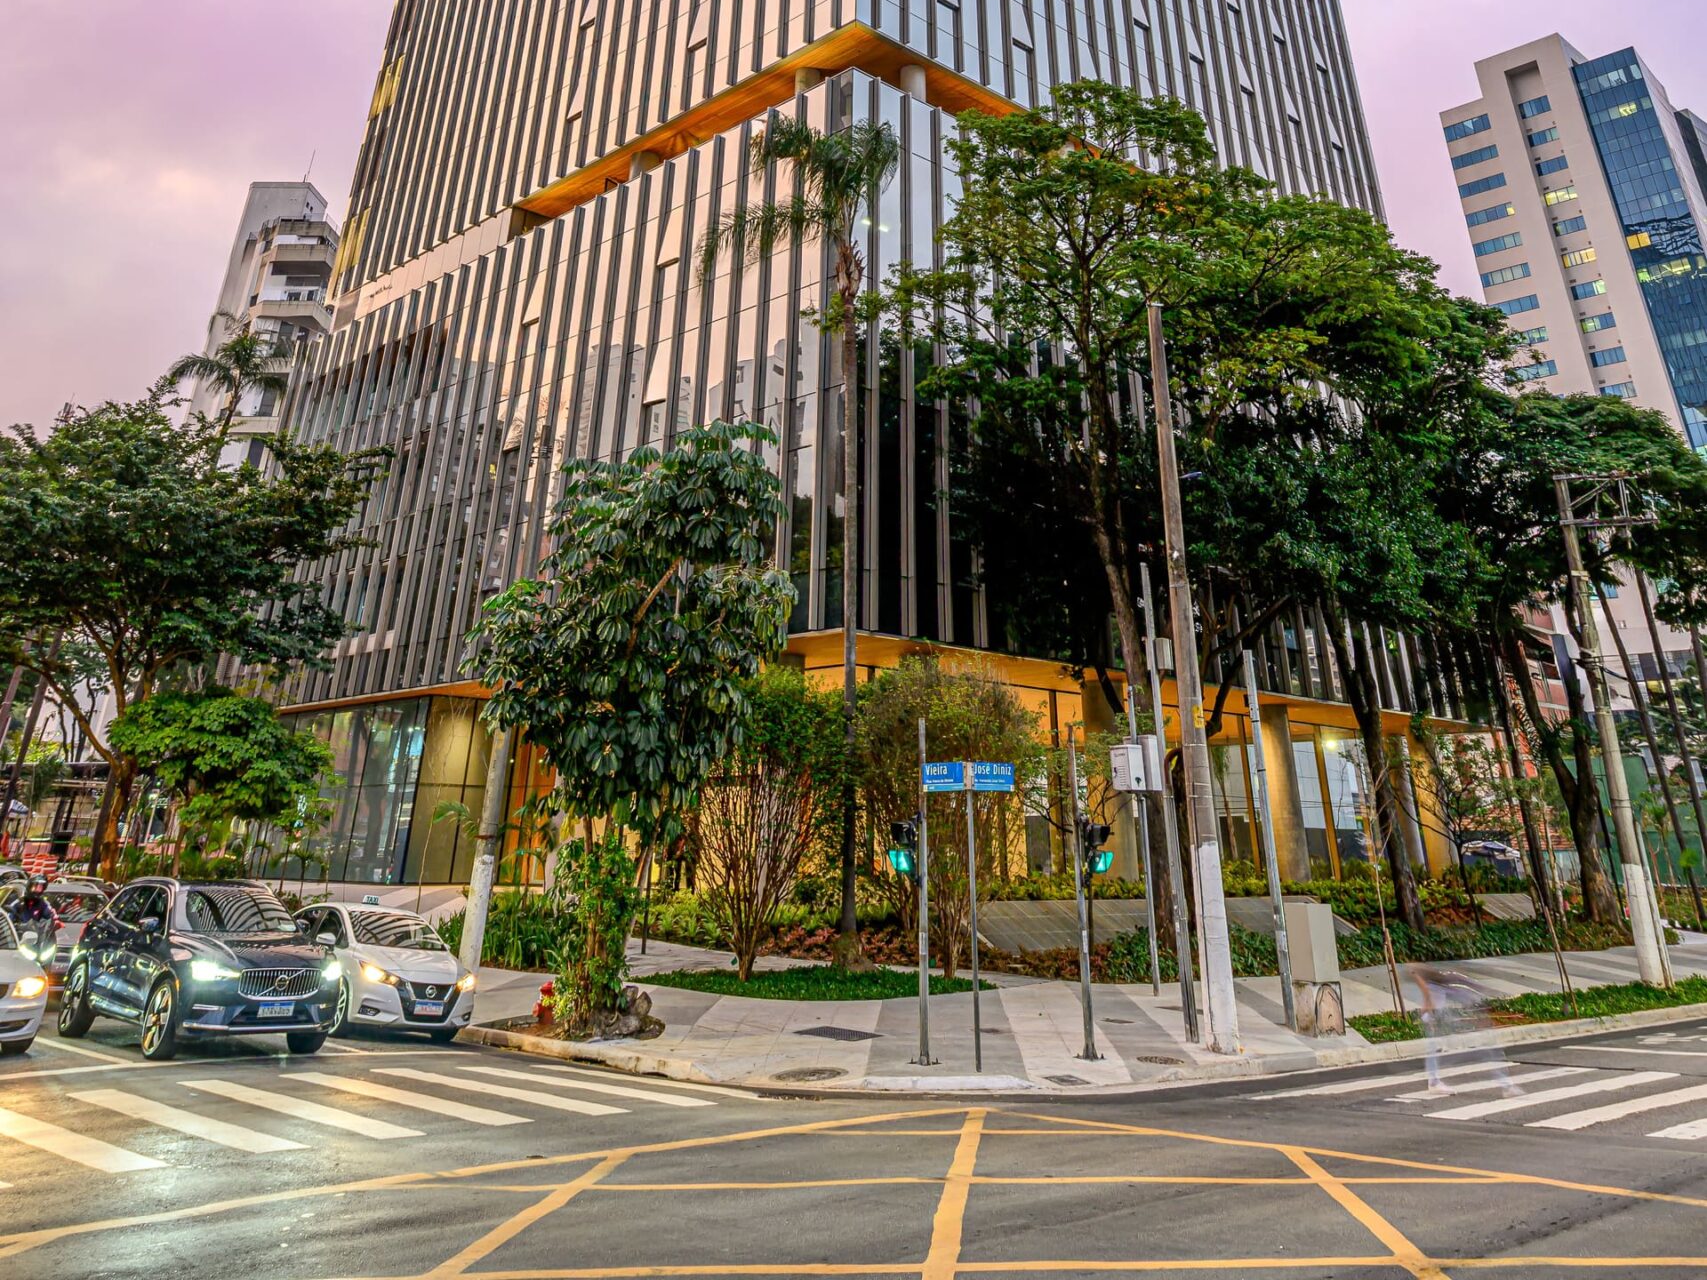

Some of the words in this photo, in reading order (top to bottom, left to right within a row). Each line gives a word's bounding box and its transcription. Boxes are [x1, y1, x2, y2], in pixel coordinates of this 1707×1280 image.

[925, 764, 948, 776] Vieira
[974, 763, 990, 775] José
[993, 764, 1011, 775] Diniz
